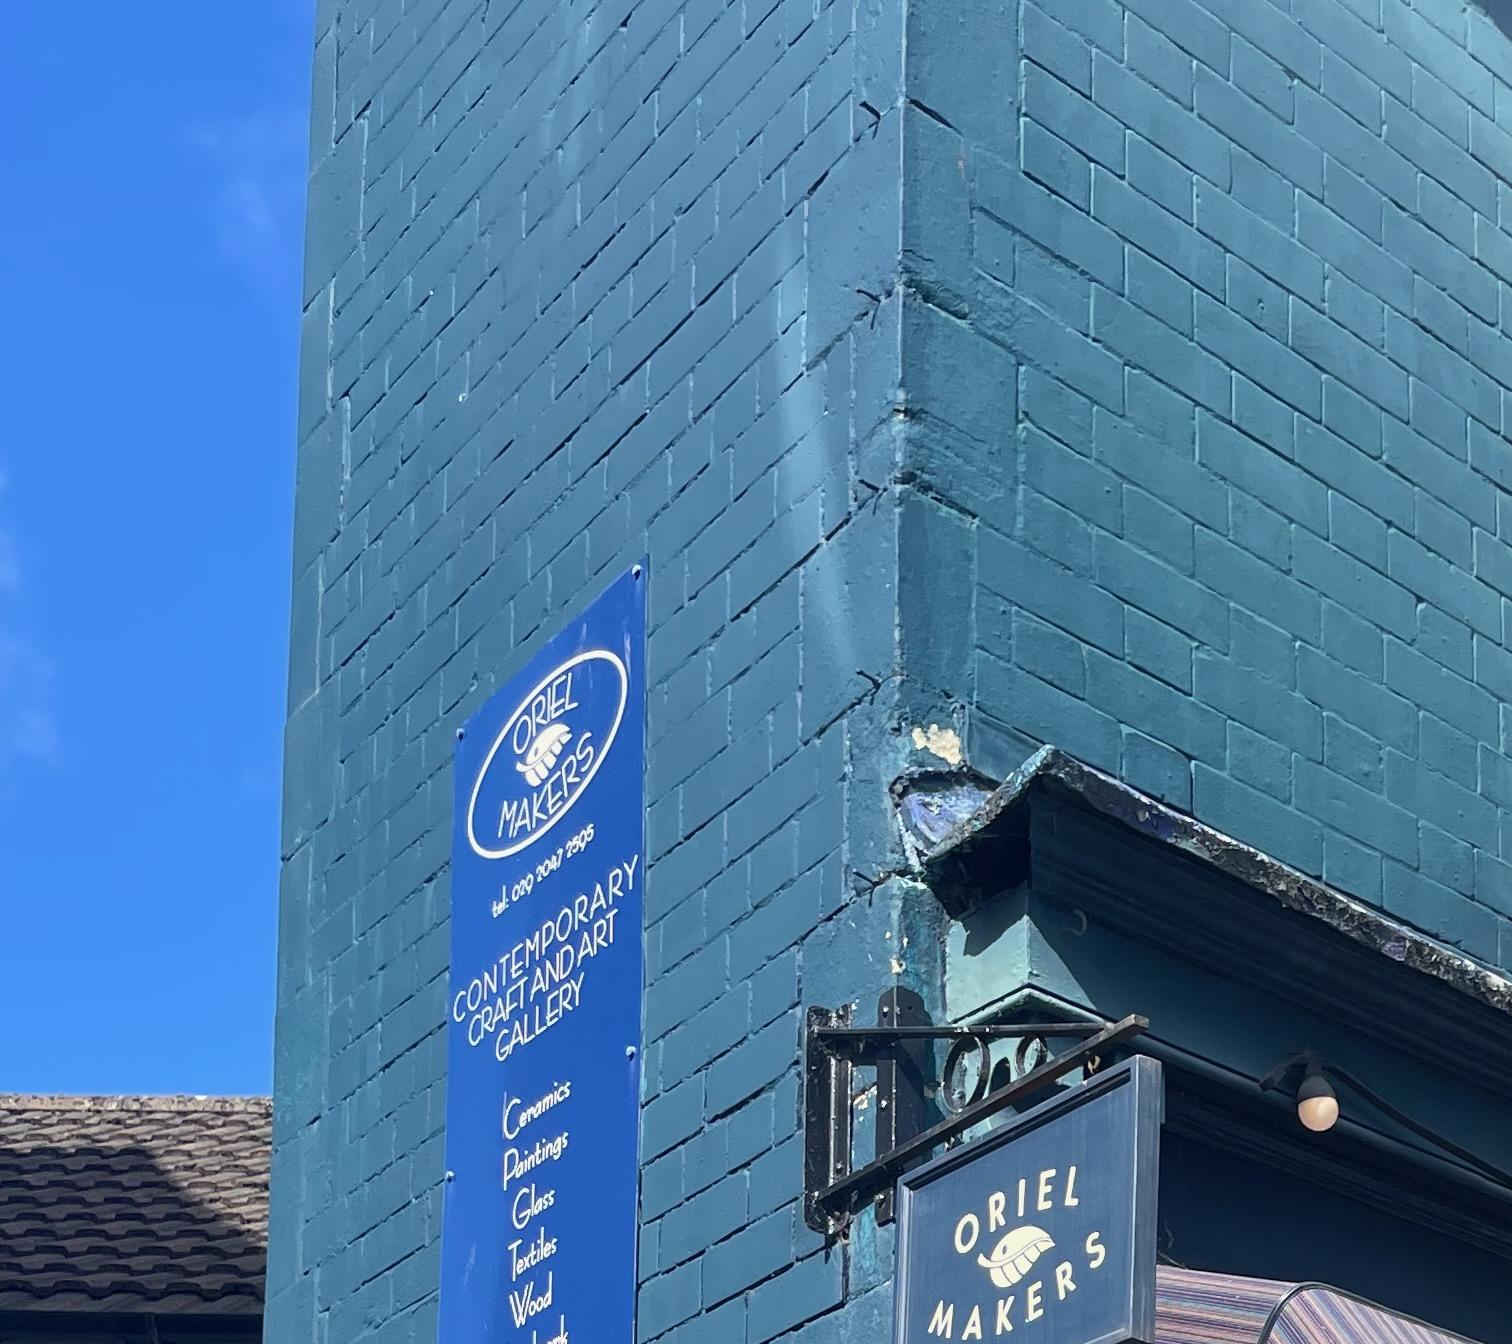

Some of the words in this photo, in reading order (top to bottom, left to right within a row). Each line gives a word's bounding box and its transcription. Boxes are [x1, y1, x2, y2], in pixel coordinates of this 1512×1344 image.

[513, 671, 578, 755] ORIEL
[498, 731, 595, 838] MAKERS
[492, 885, 509, 918] tel:
[512, 874, 534, 902] 029
[536, 848, 563, 882] 2047
[453, 854, 638, 1022] CONTEMPORARY
[468, 976, 528, 1046] CRAFT
[530, 944, 574, 1002] AND
[577, 908, 618, 967] ART
[495, 972, 584, 1061] GALLERY
[504, 1081, 572, 1140] Ceramics
[503, 1132, 569, 1191] Paintings
[512, 1183, 555, 1229] Glass
[954, 1165, 1079, 1254] ORIEL
[508, 1227, 557, 1281] Textiles
[928, 1232, 1106, 1341] MAKERS
[509, 1271, 552, 1328] Wood
